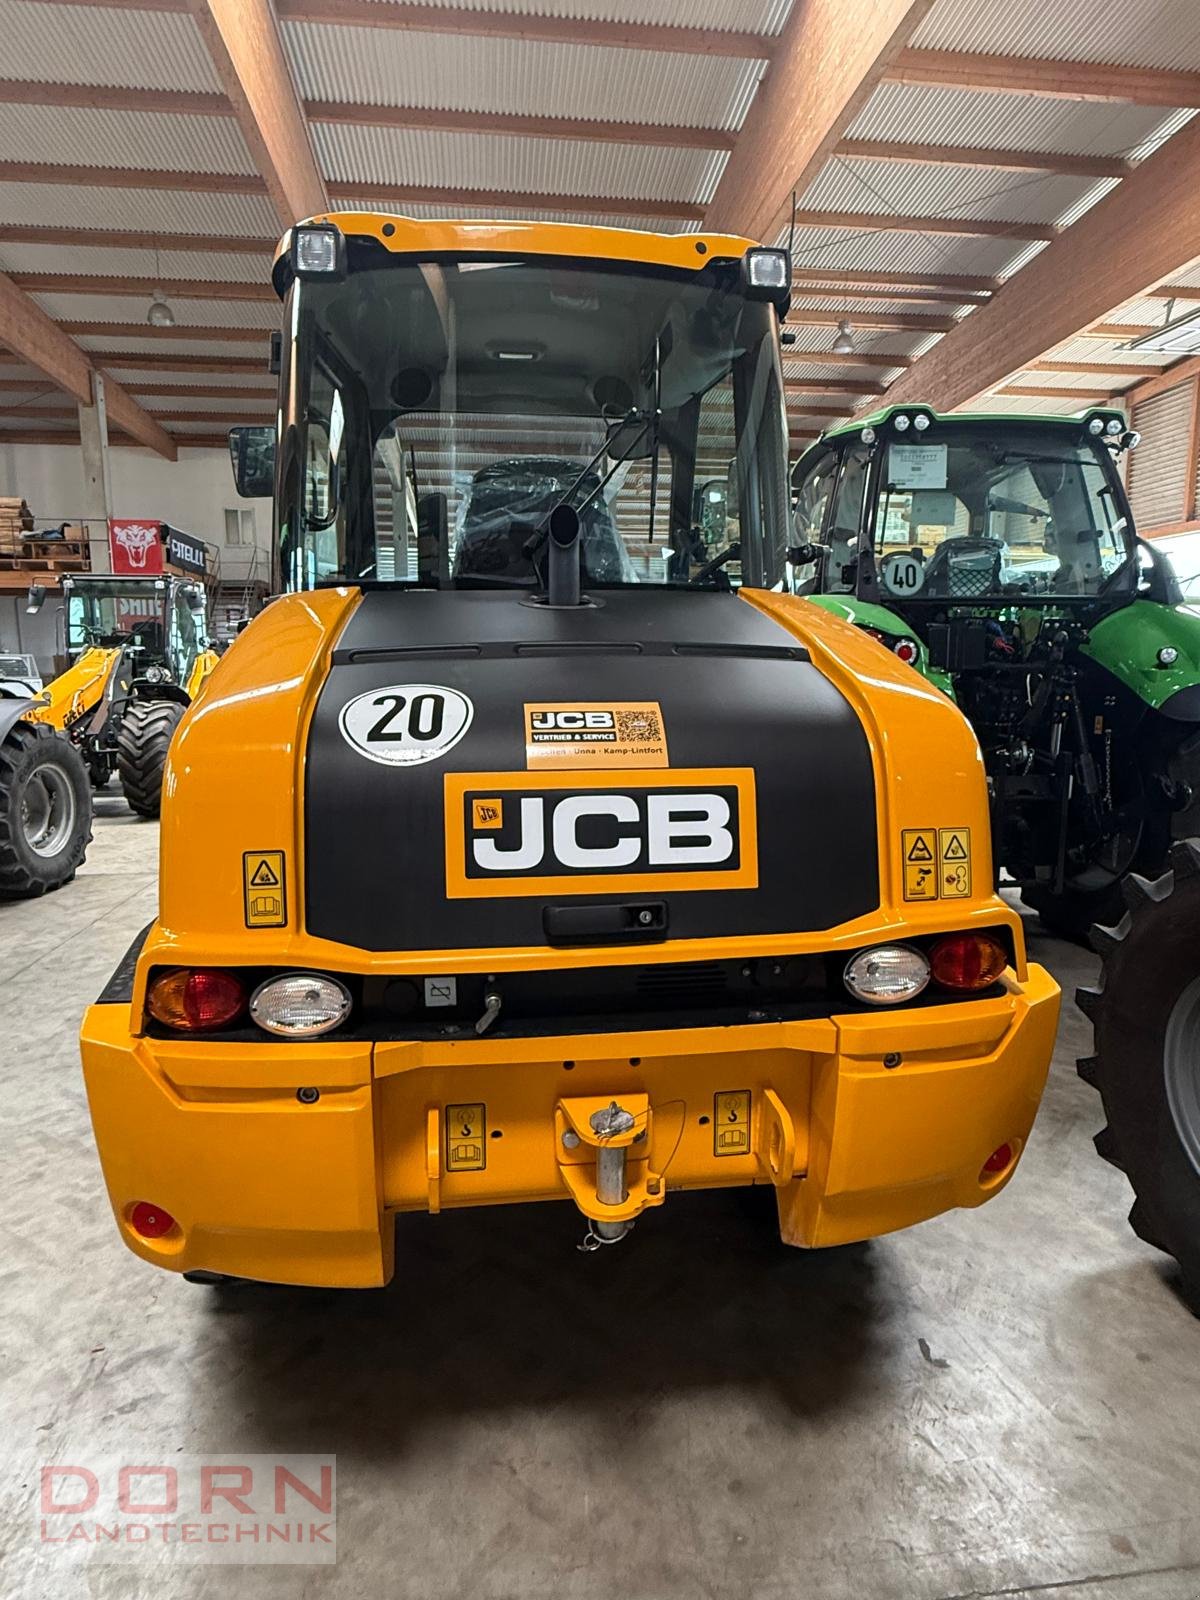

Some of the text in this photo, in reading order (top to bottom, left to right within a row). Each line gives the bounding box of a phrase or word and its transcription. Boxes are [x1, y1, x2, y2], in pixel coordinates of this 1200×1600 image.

[893, 563, 917, 588] 40
[366, 693, 445, 742] 20
[533, 711, 613, 729] JCB
[533, 733, 572, 741] VERTRIEB
[582, 733, 615, 741] SERVICE
[603, 747, 663, 755] Kamp-Lintfort
[480, 806, 498, 821] JCB
[472, 793, 734, 871] JCB
